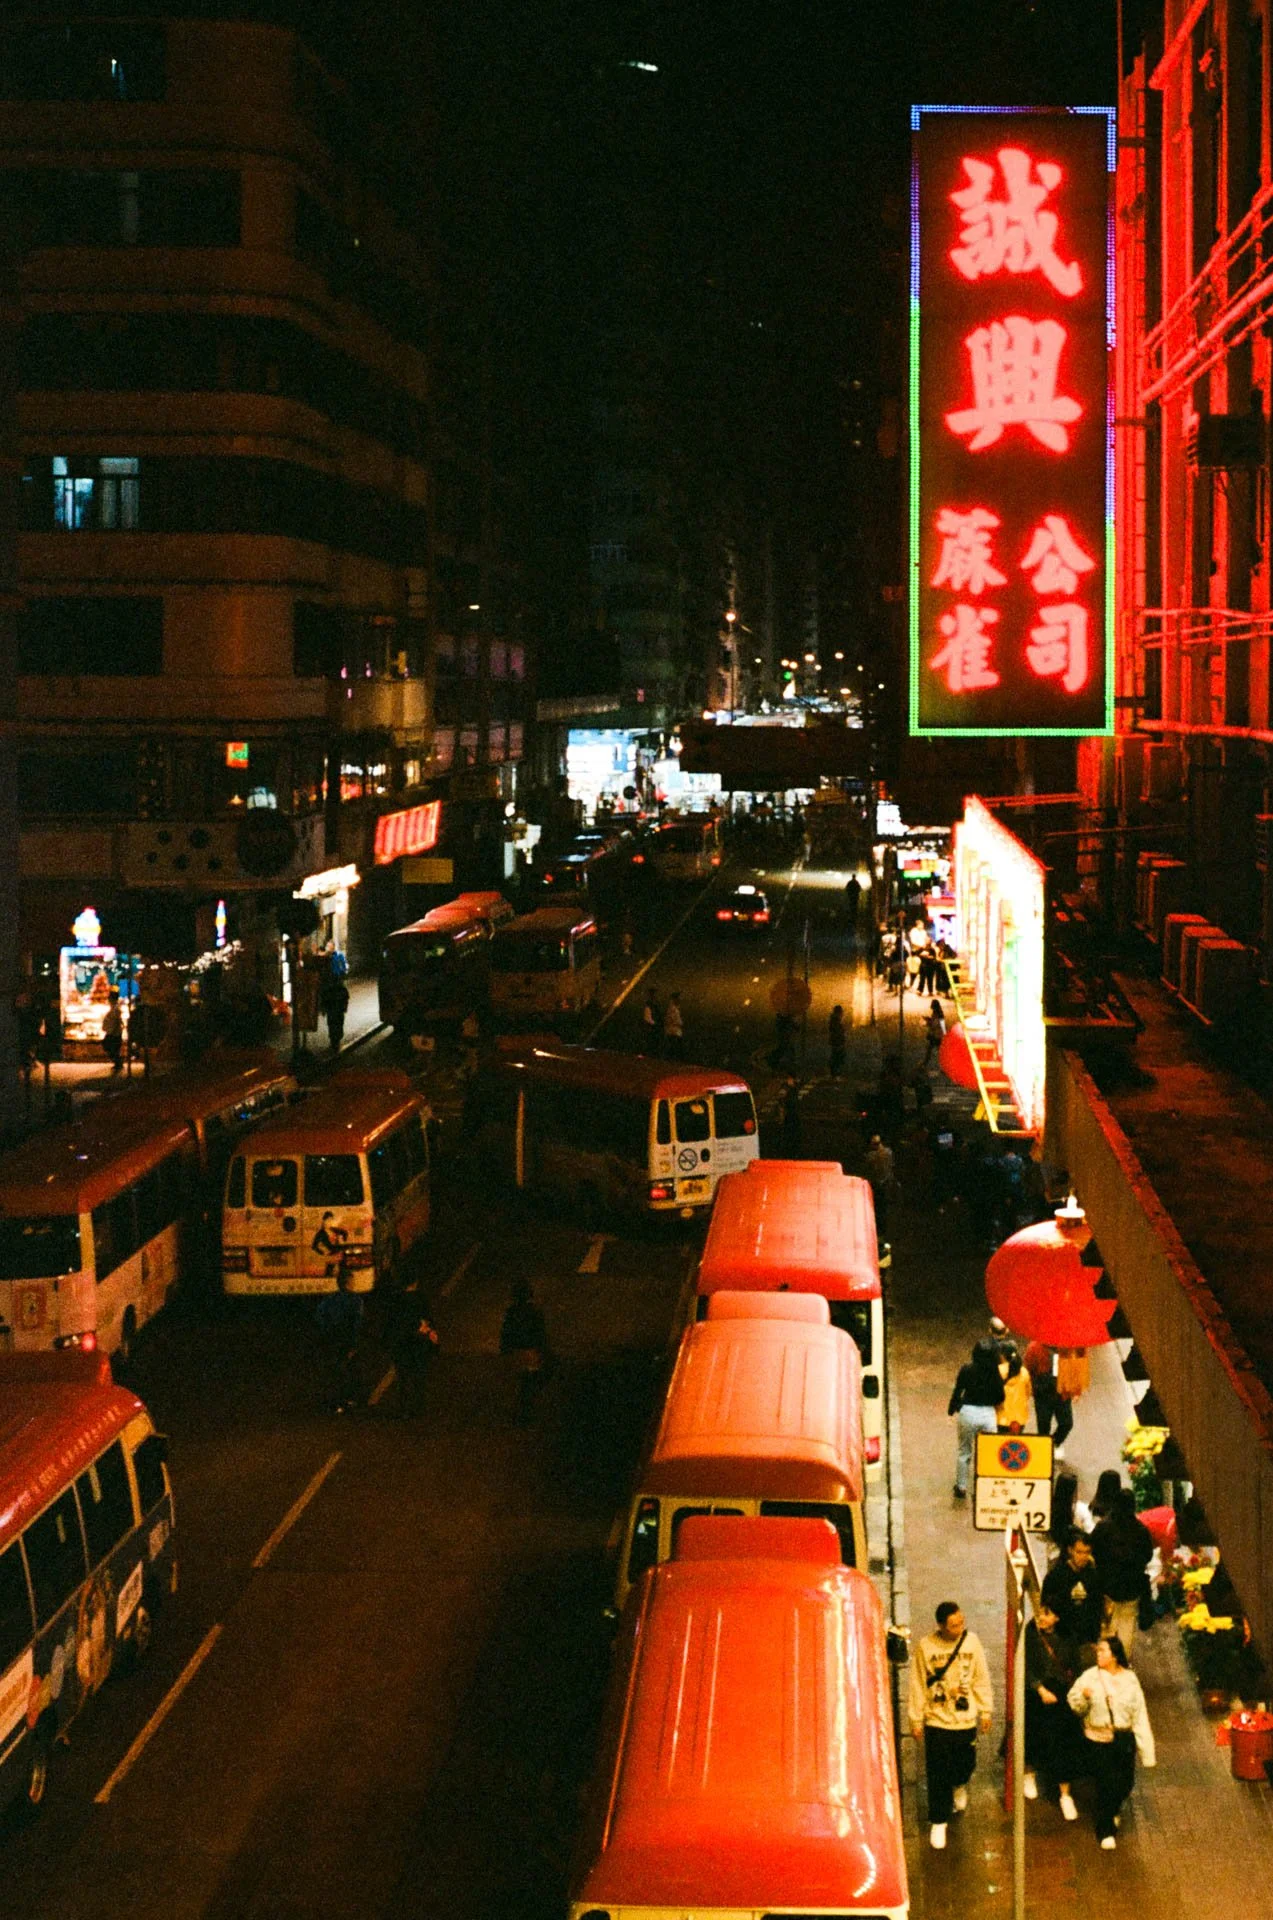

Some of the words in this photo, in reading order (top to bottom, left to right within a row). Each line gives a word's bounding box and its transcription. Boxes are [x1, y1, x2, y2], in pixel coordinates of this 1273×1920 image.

[945, 147, 1084, 455] 誠興
[1020, 514, 1097, 694] 公司
[1024, 1481, 1036, 1500] 7
[1024, 1511, 1046, 1530] 12
